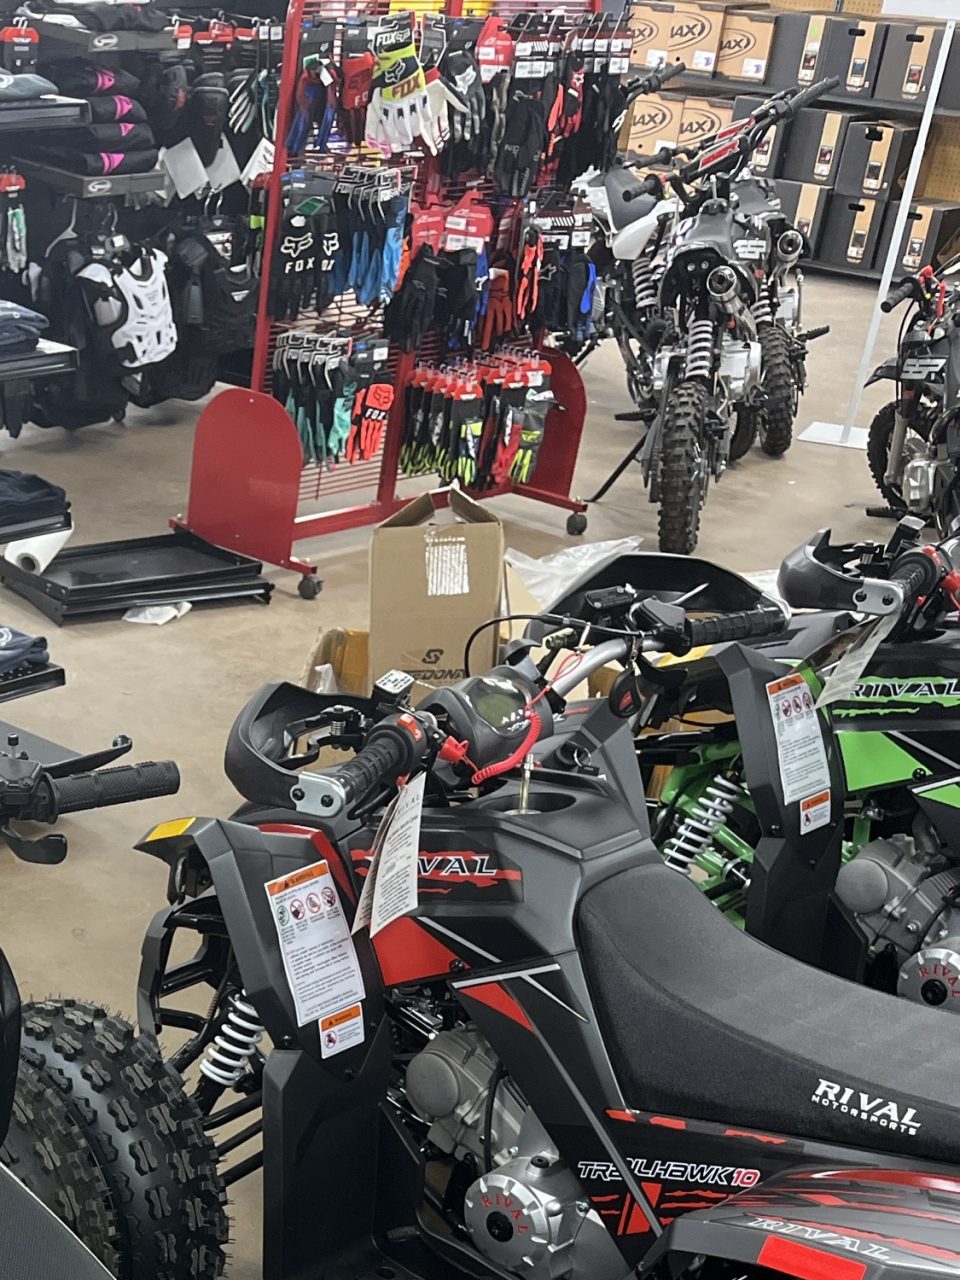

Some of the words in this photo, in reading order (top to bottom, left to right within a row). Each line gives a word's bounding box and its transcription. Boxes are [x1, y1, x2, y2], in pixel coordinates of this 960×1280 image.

[376, 31, 397, 47] FOX
[391, 73, 420, 99] FOX
[354, 91, 369, 106] FO
[285, 257, 315, 273] FOX
[365, 408, 386, 419] FOX
[850, 678, 960, 699] RIVAL
[815, 1078, 922, 1128] RIVAL
[811, 1094, 917, 1136] MOTORSPORTS
[731, 1168, 761, 1187] 10
[481, 1192, 529, 1235] RIVAL
[746, 1217, 891, 1261] RIVAL
